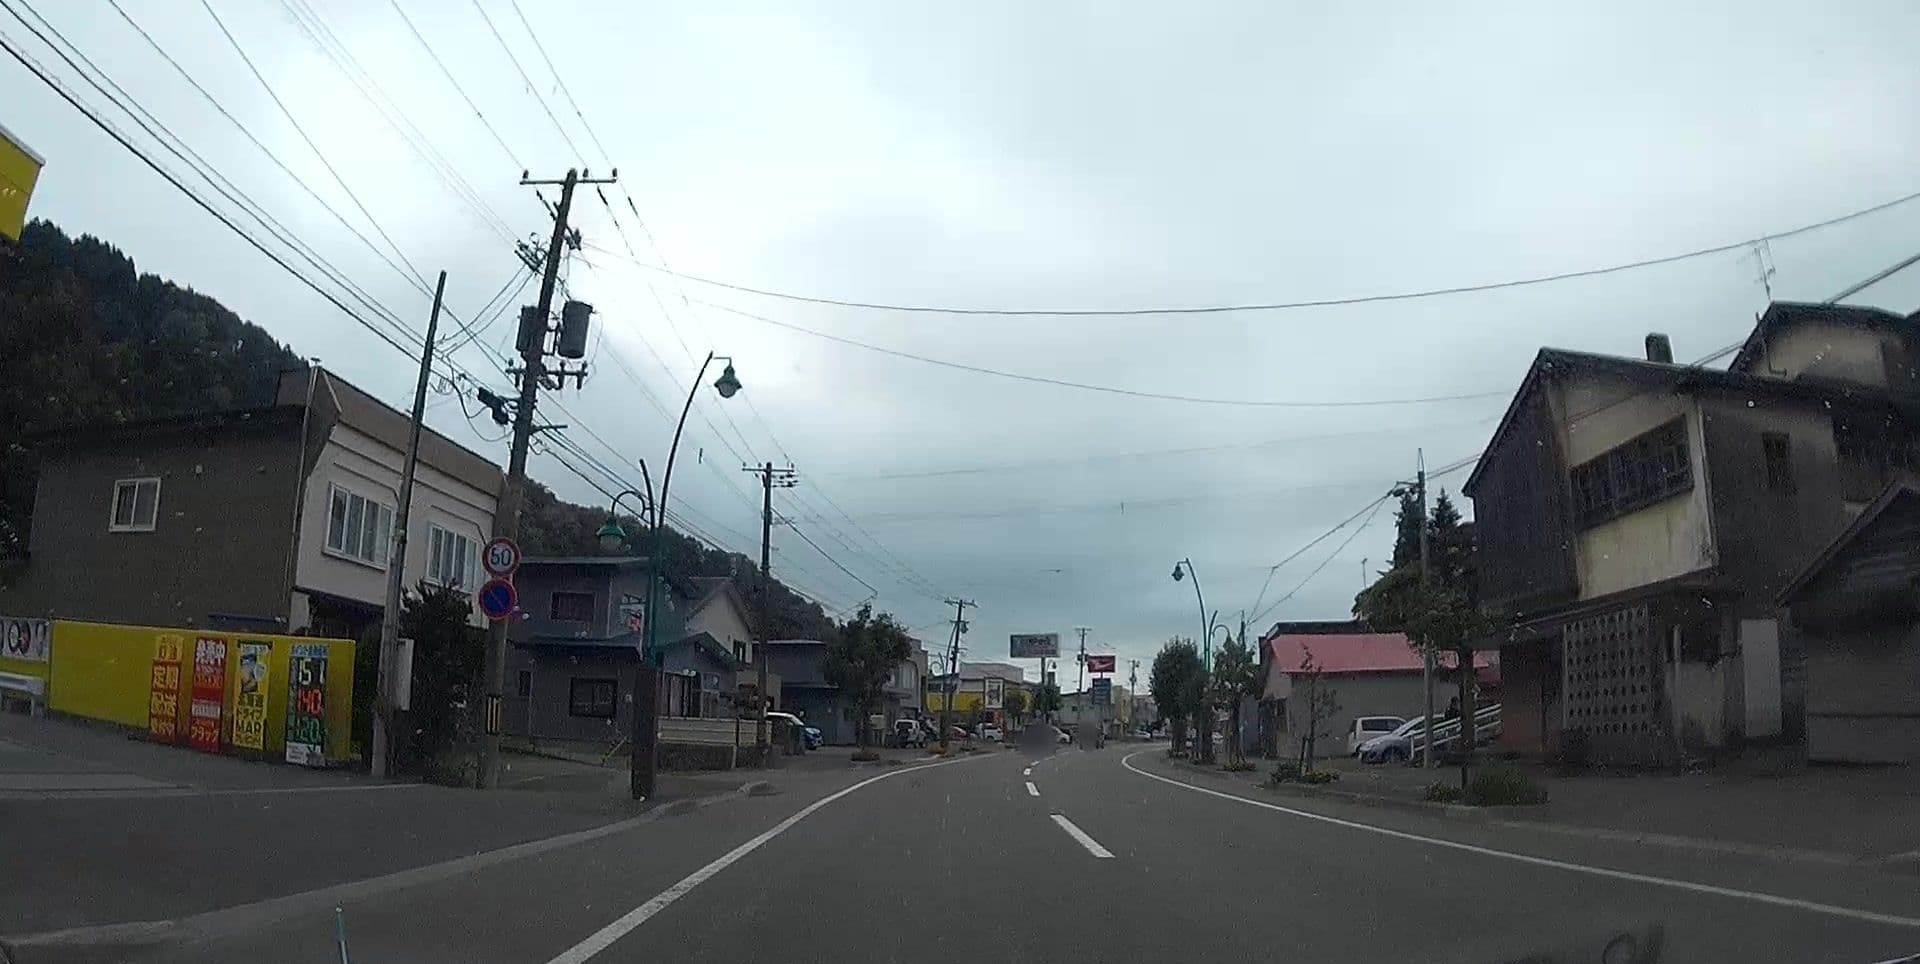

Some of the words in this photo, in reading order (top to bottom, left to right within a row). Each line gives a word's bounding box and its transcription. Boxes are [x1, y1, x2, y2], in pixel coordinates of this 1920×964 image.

[491, 548, 511, 566] 50
[153, 665, 179, 690] 定期
[297, 688, 322, 714] 140
